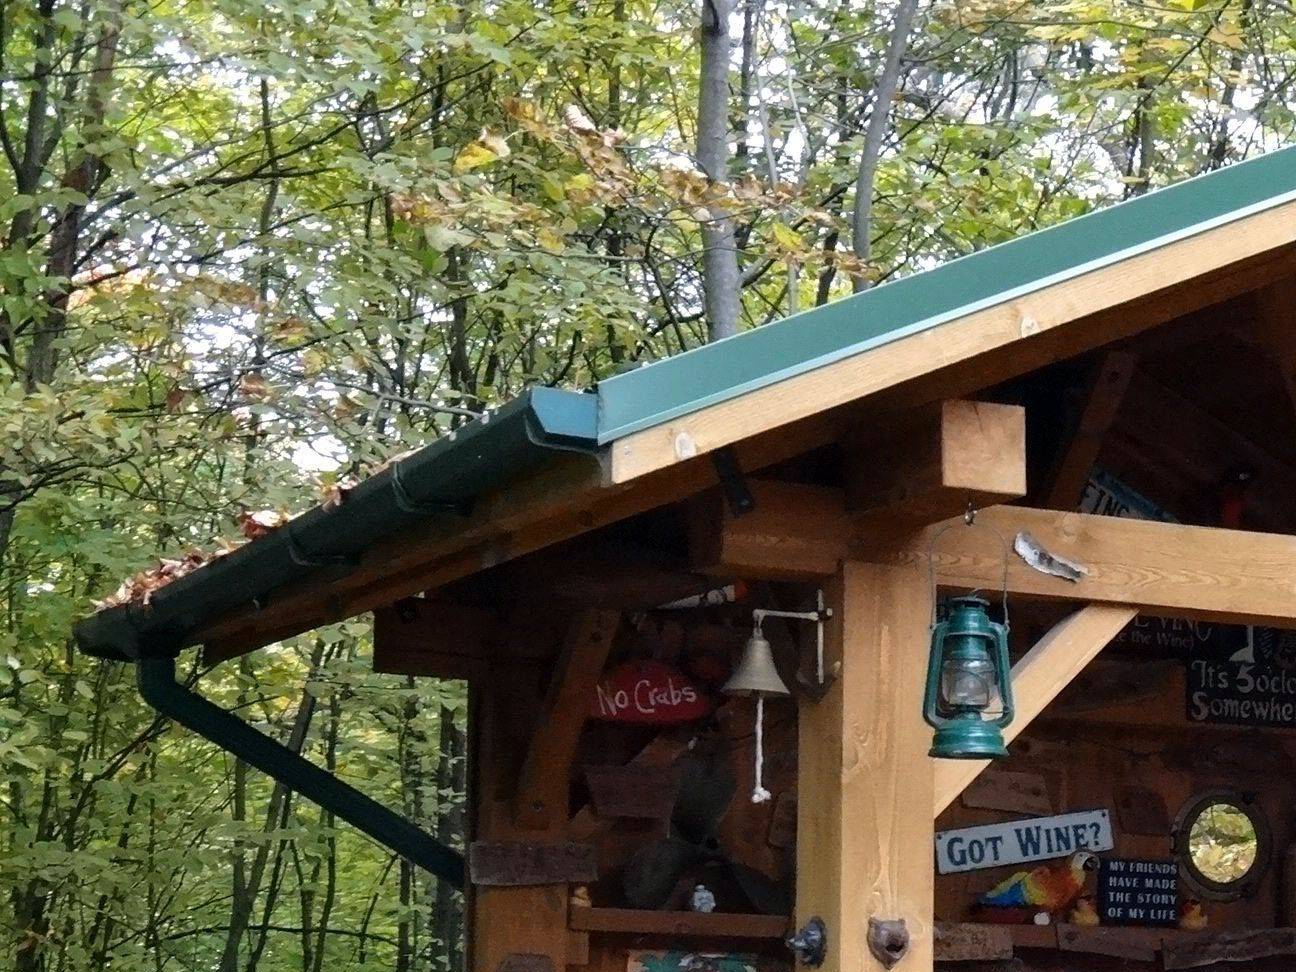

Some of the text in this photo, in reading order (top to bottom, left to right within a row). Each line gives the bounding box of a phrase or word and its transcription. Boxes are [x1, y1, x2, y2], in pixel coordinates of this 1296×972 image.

[597, 677, 698, 716] No Crabs
[1109, 861, 1177, 875] MY FRIENDS
[1108, 876, 1177, 890] HAVE MADE
[1108, 891, 1177, 905] THE STORY
[1107, 907, 1177, 921] OF MY LIFE
